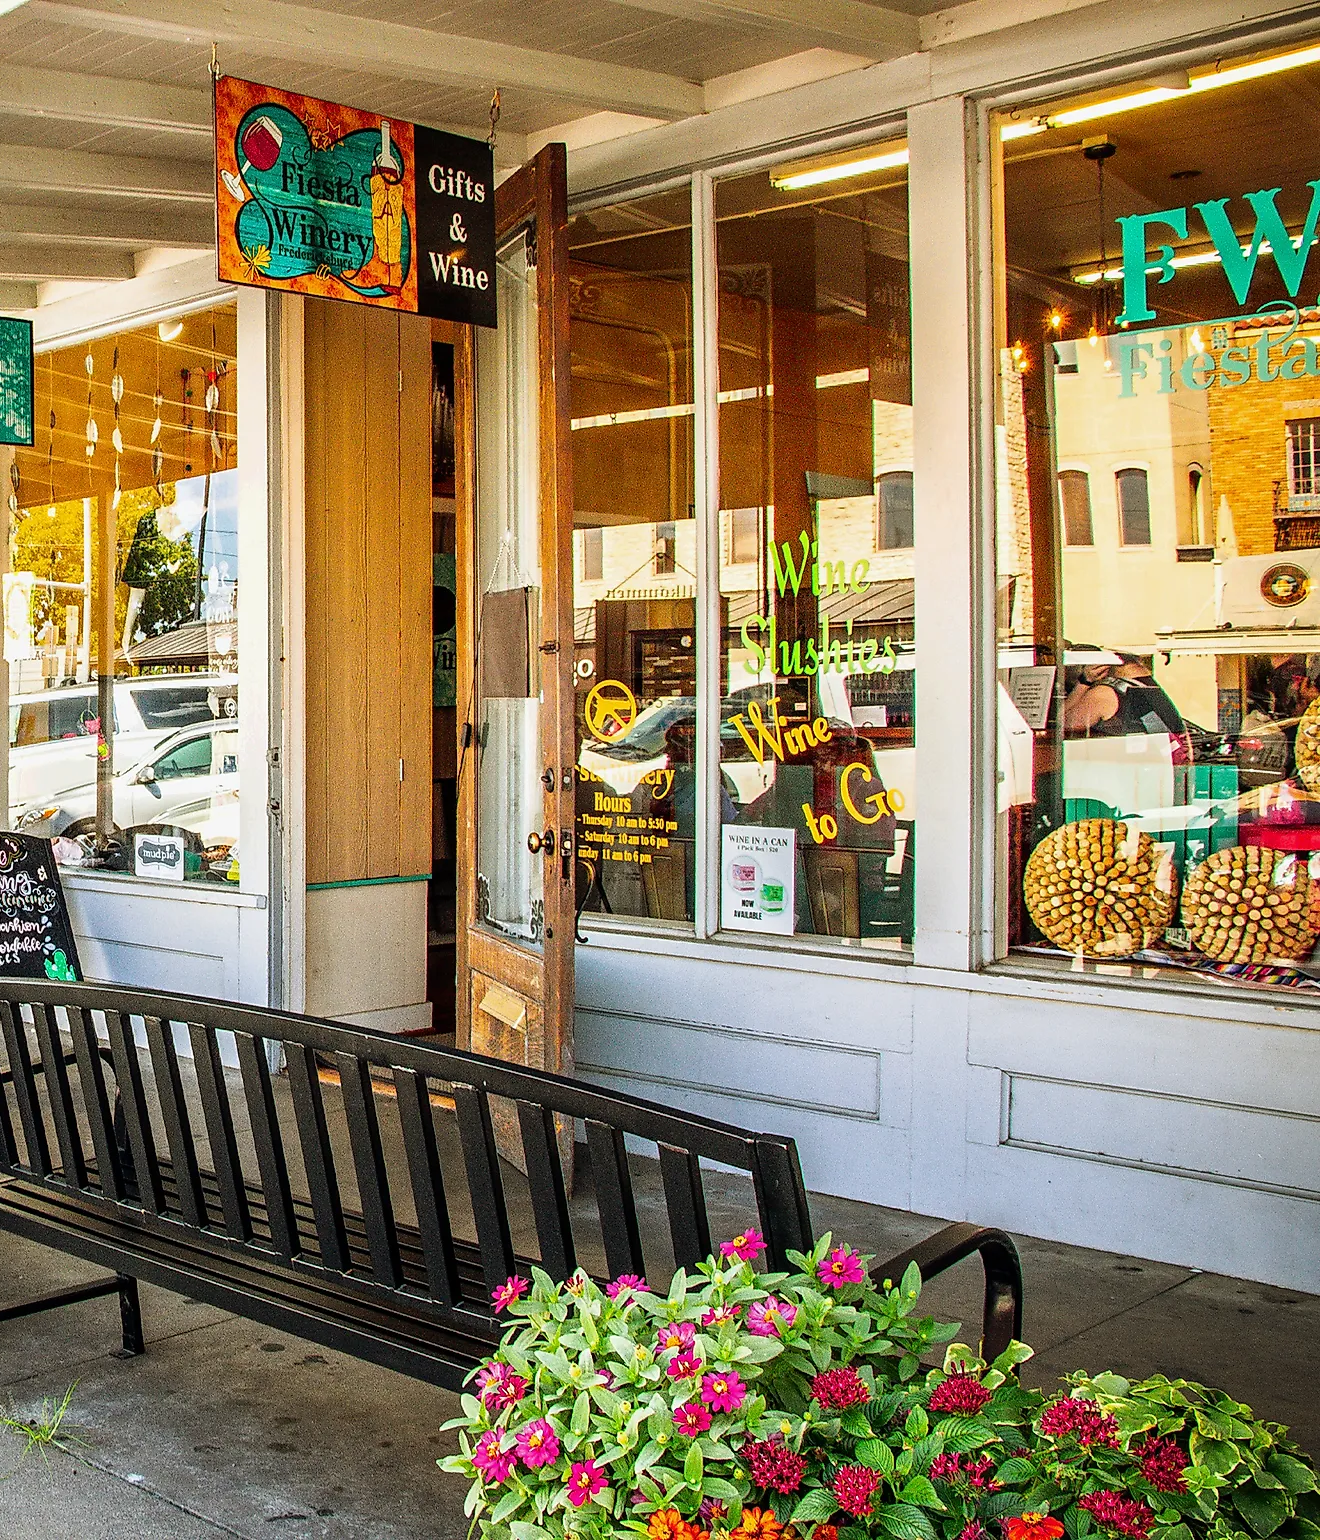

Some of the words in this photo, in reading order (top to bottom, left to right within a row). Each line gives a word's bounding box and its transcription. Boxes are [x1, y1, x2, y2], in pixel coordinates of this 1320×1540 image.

[281, 160, 363, 207] Fiesta
[429, 165, 486, 203] Gifts
[271, 208, 373, 259] Winery
[449, 213, 468, 243] &
[429, 251, 489, 290] Wine
[1117, 312, 1320, 398] Fiesta
[768, 530, 873, 598] Wine
[741, 614, 897, 676] Slushies
[727, 697, 833, 767] Wine
[594, 792, 632, 813] Hours
[802, 802, 838, 845] to
[841, 762, 905, 825] Go
[582, 814, 613, 829] Thursday
[616, 816, 625, 827] 10
[626, 819, 637, 829] am
[638, 818, 647, 828] to
[648, 818, 664, 829] 5:30
[666, 820, 678, 833] pm
[585, 831, 615, 845] Saturday
[618, 833, 628, 844] 10
[628, 836, 639, 845] am
[641, 834, 649, 846] to
[650, 835, 655, 846] 6
[656, 838, 669, 849] pm
[143, 846, 175, 862] mudpie
[578, 847, 599, 859] unday
[602, 848, 610, 859] 11
[612, 852, 623, 861] am
[624, 850, 632, 862] to
[633, 850, 639, 862] 6
[640, 853, 652, 865] pm
[729, 835, 749, 844] WINE
[752, 837, 759, 845] IN
[762, 837, 768, 846] A
[771, 838, 788, 847] CAN
[733, 910, 762, 921] AVAILABLE
[741, 899, 755, 908] NOW
